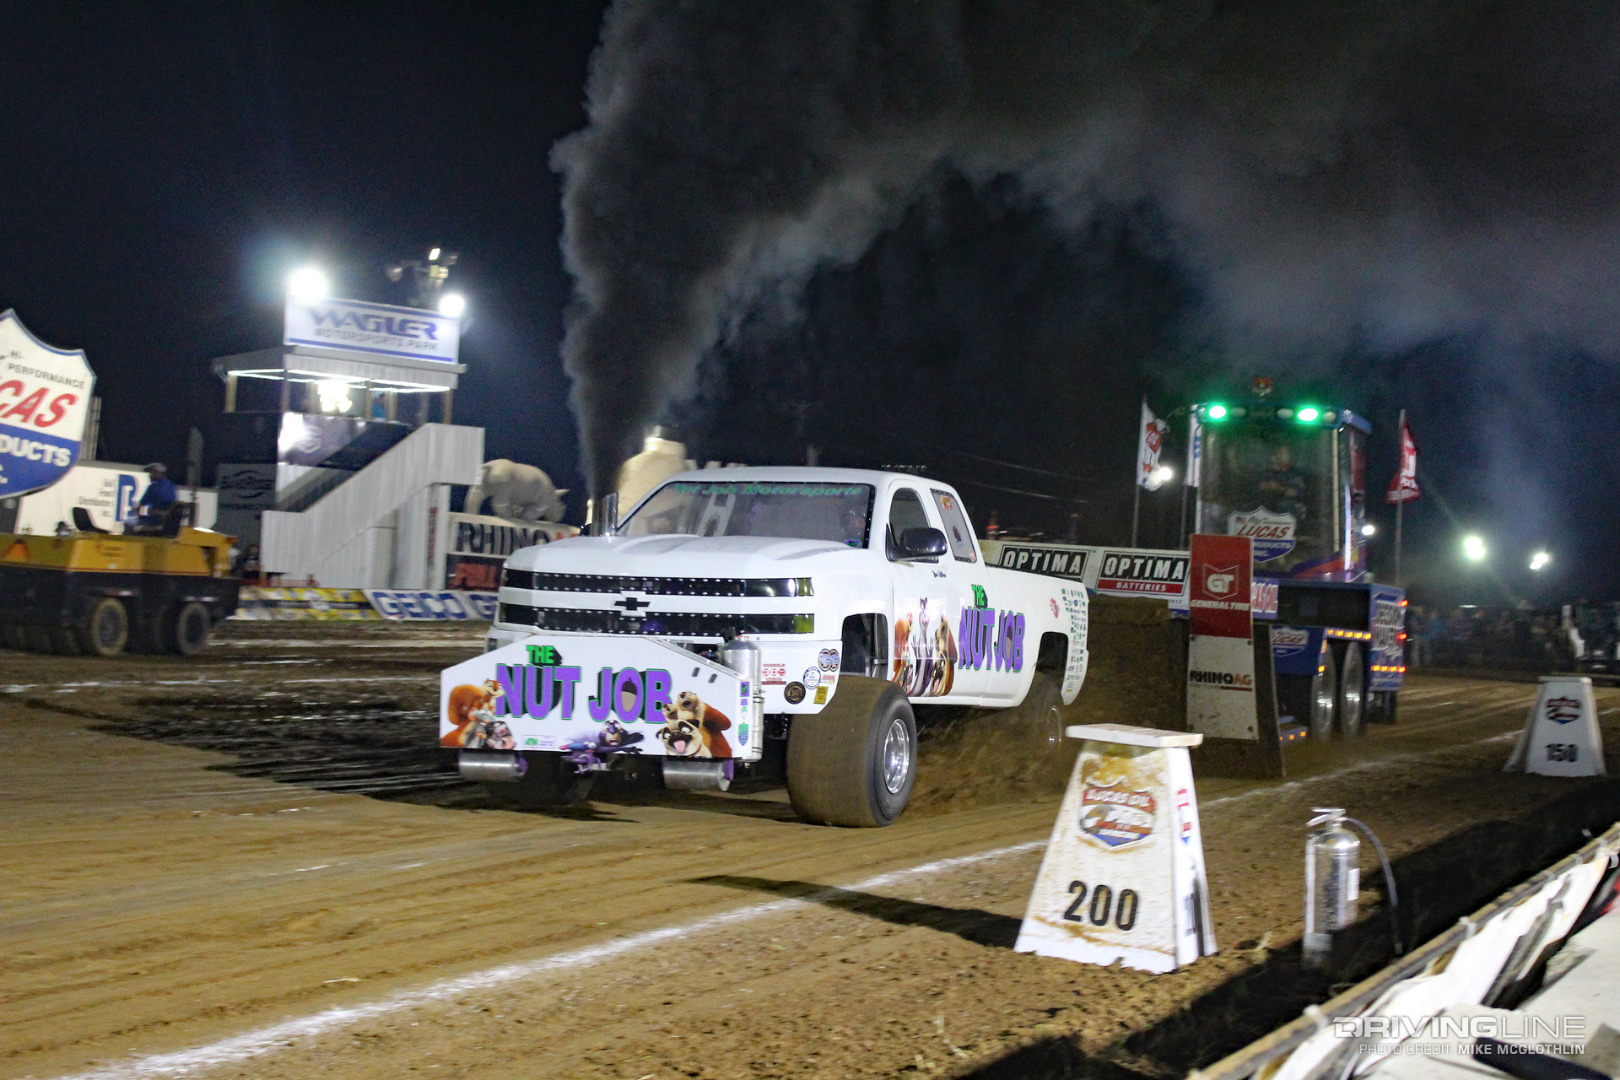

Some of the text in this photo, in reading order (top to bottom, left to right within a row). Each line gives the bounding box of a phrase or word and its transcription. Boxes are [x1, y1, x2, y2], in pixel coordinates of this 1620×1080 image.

[307, 308, 438, 340] WAGLER
[8, 362, 86, 390] PERFORMANCE
[0, 377, 79, 428] CAS
[702, 485, 738, 495] Job
[742, 485, 863, 497] Motorsports
[1237, 525, 1292, 539] LUCAS
[1003, 550, 1082, 574] OPTIMA
[1103, 556, 1185, 580] OPTIMA
[971, 584, 987, 607] THE
[1116, 581, 1167, 592] BATTERIES
[1206, 573, 1235, 594] GT
[372, 591, 472, 619] GEICO
[1190, 600, 1230, 610] GENERAL
[1229, 601, 1250, 611] TIRE
[958, 606, 995, 671] NUT
[994, 609, 1026, 673] JOB
[526, 645, 560, 665] THE
[495, 663, 673, 724] NUT JOB
[1063, 880, 1139, 931] 200
